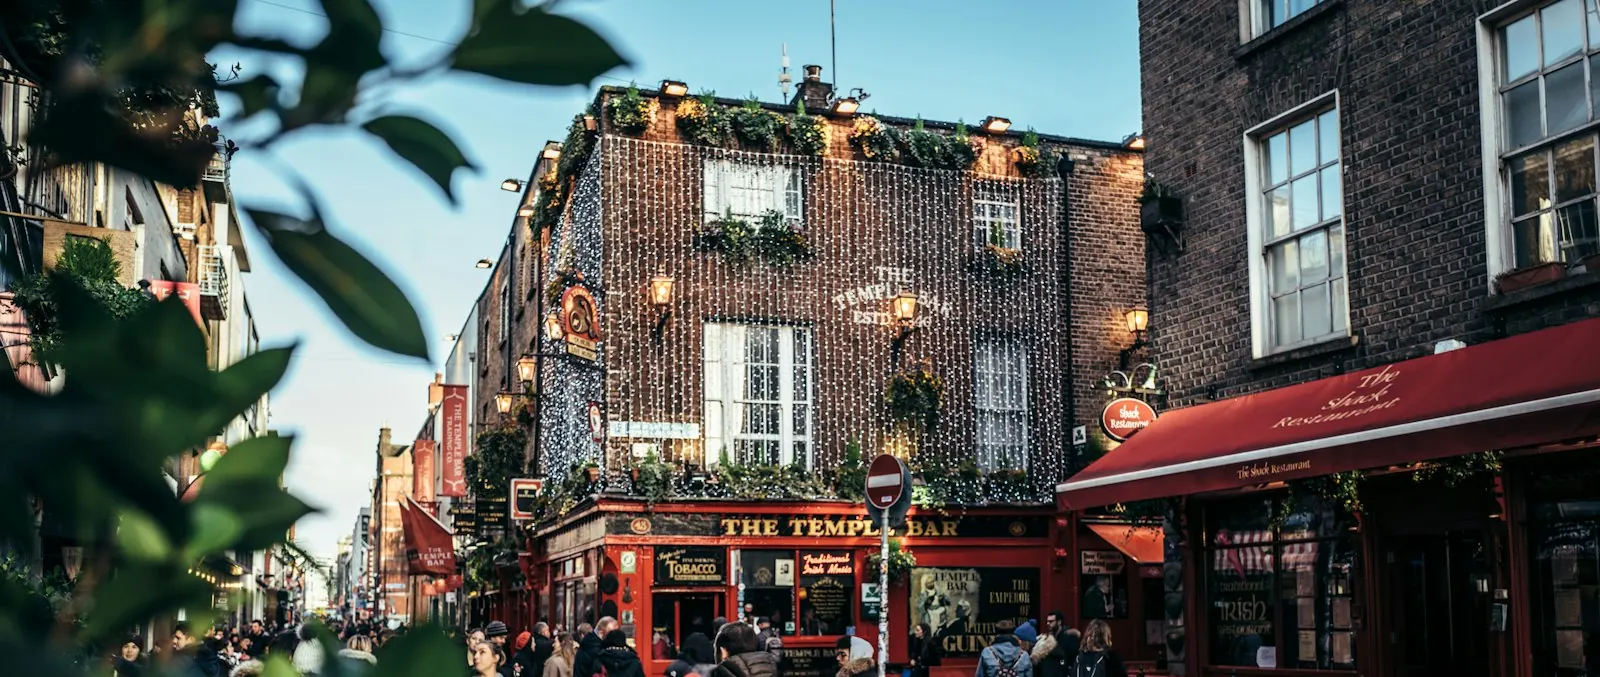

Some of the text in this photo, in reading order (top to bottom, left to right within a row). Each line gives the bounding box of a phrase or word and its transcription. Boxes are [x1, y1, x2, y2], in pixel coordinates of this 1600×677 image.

[875, 265, 914, 283] THE
[1356, 364, 1400, 388] The
[1321, 384, 1393, 410] Shack
[1119, 404, 1140, 420] Shack
[1270, 397, 1401, 428] Restaurant
[454, 403, 462, 477] THE TEMPLE BAR
[1237, 459, 1311, 480] The Shack Restaurant
[721, 518, 779, 536] THE
[906, 519, 958, 537] BAR
[418, 552, 451, 560] TEMPLE
[427, 559, 445, 567] BAR
[803, 552, 851, 564] Traditional
[665, 560, 717, 579] TOBACCO
[802, 563, 825, 575] Irish
[827, 563, 853, 575] Music
[934, 572, 977, 582] TEMPLE
[947, 581, 968, 592] BAR
[1011, 579, 1031, 591] THE
[989, 591, 1031, 604] EMPEROR
